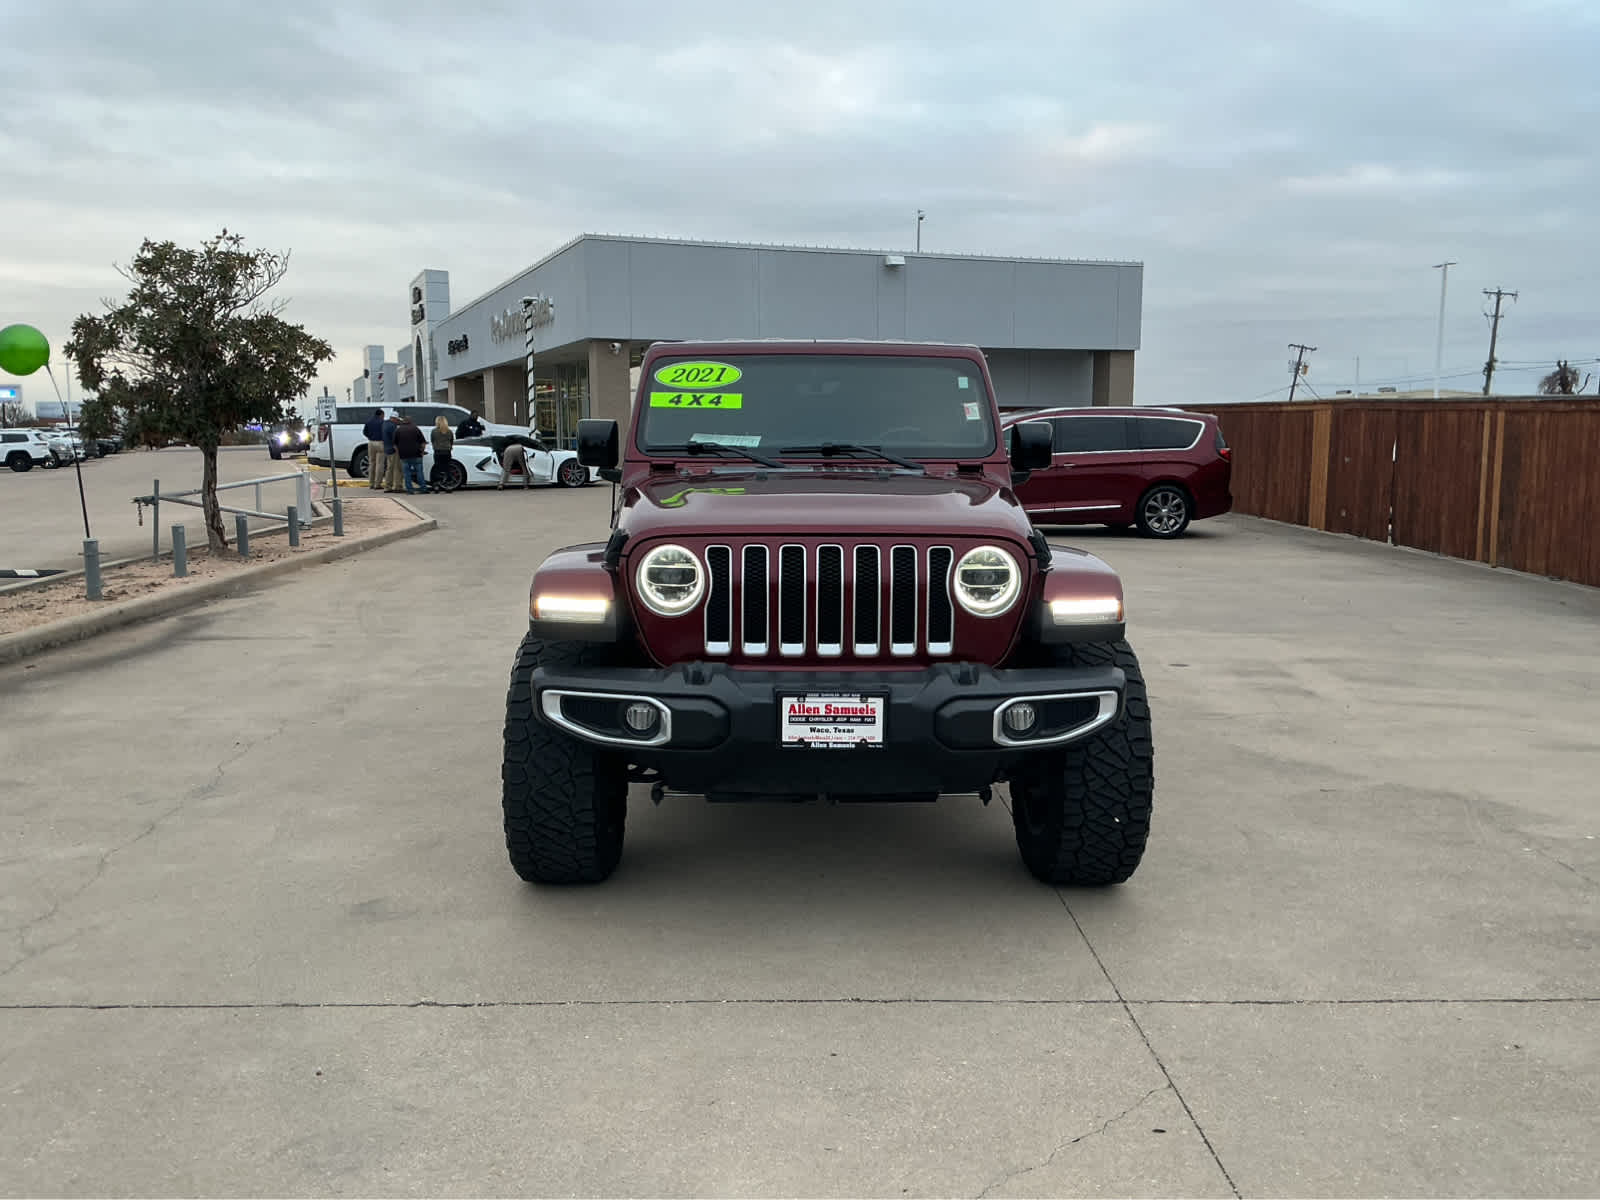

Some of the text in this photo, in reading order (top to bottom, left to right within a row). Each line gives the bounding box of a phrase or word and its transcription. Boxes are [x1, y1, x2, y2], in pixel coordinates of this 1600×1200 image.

[670, 367, 728, 383] 2021
[324, 410, 332, 420] 5
[788, 704, 877, 715] Allen Samuels
[809, 726, 832, 734] Waco,
